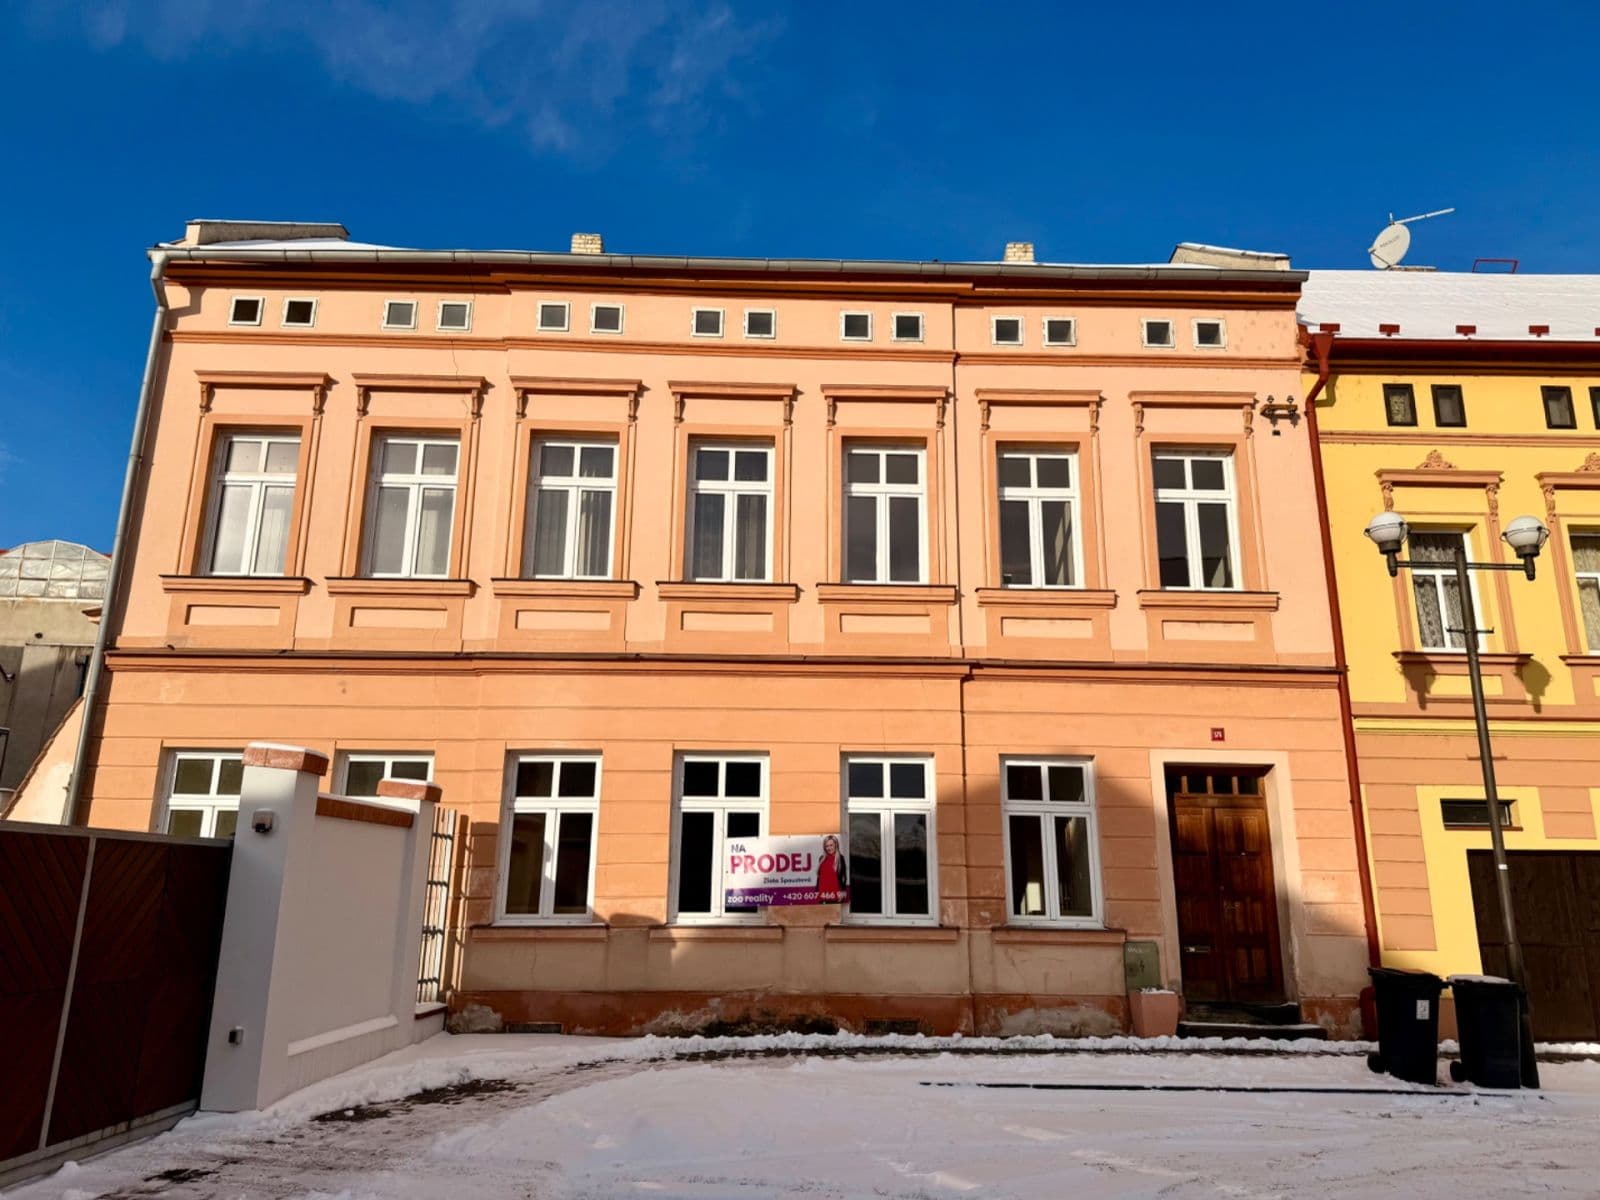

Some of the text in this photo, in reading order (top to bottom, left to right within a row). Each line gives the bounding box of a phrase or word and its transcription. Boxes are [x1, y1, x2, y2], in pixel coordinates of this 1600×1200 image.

[731, 844, 746, 853] NA
[730, 853, 812, 874] PRODEJ
[727, 893, 774, 904] zoo reality
[783, 892, 802, 901] +420
[803, 891, 819, 900] 607
